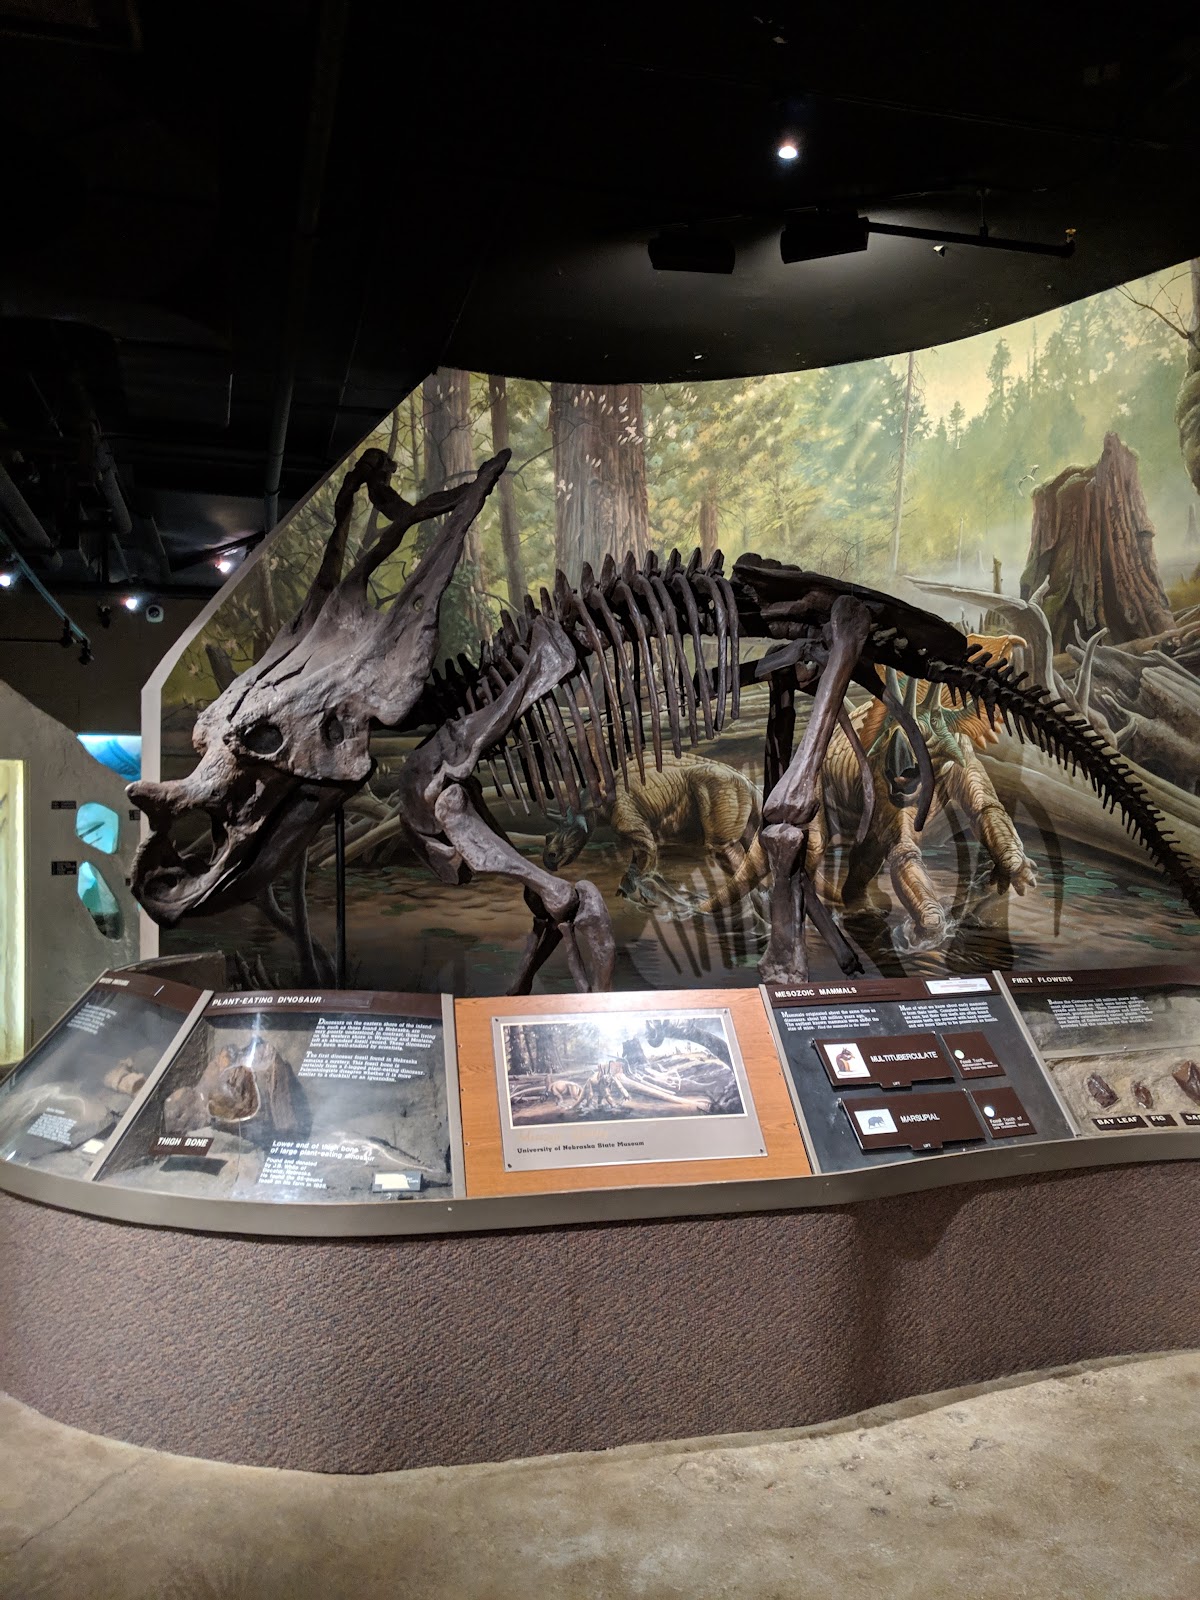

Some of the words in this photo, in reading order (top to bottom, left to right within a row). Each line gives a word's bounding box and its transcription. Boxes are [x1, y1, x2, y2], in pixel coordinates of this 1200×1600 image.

[775, 989, 815, 998] MESOZOIC
[818, 987, 857, 995] MAMMALS
[212, 996, 273, 1006] PLANT-EATING
[870, 1051, 938, 1063] MULTITUBERCULATE
[900, 1113, 940, 1123] MARSUPIAL
[1117, 1116, 1137, 1124] LEAF
[157, 1137, 182, 1146] THIGH
[184, 1138, 209, 1147] BONE
[272, 1140, 294, 1148] Lower
[299, 1149, 343, 1160] plant-eating
[345, 1152, 375, 1161] dinosaur
[517, 1146, 553, 1154] University
